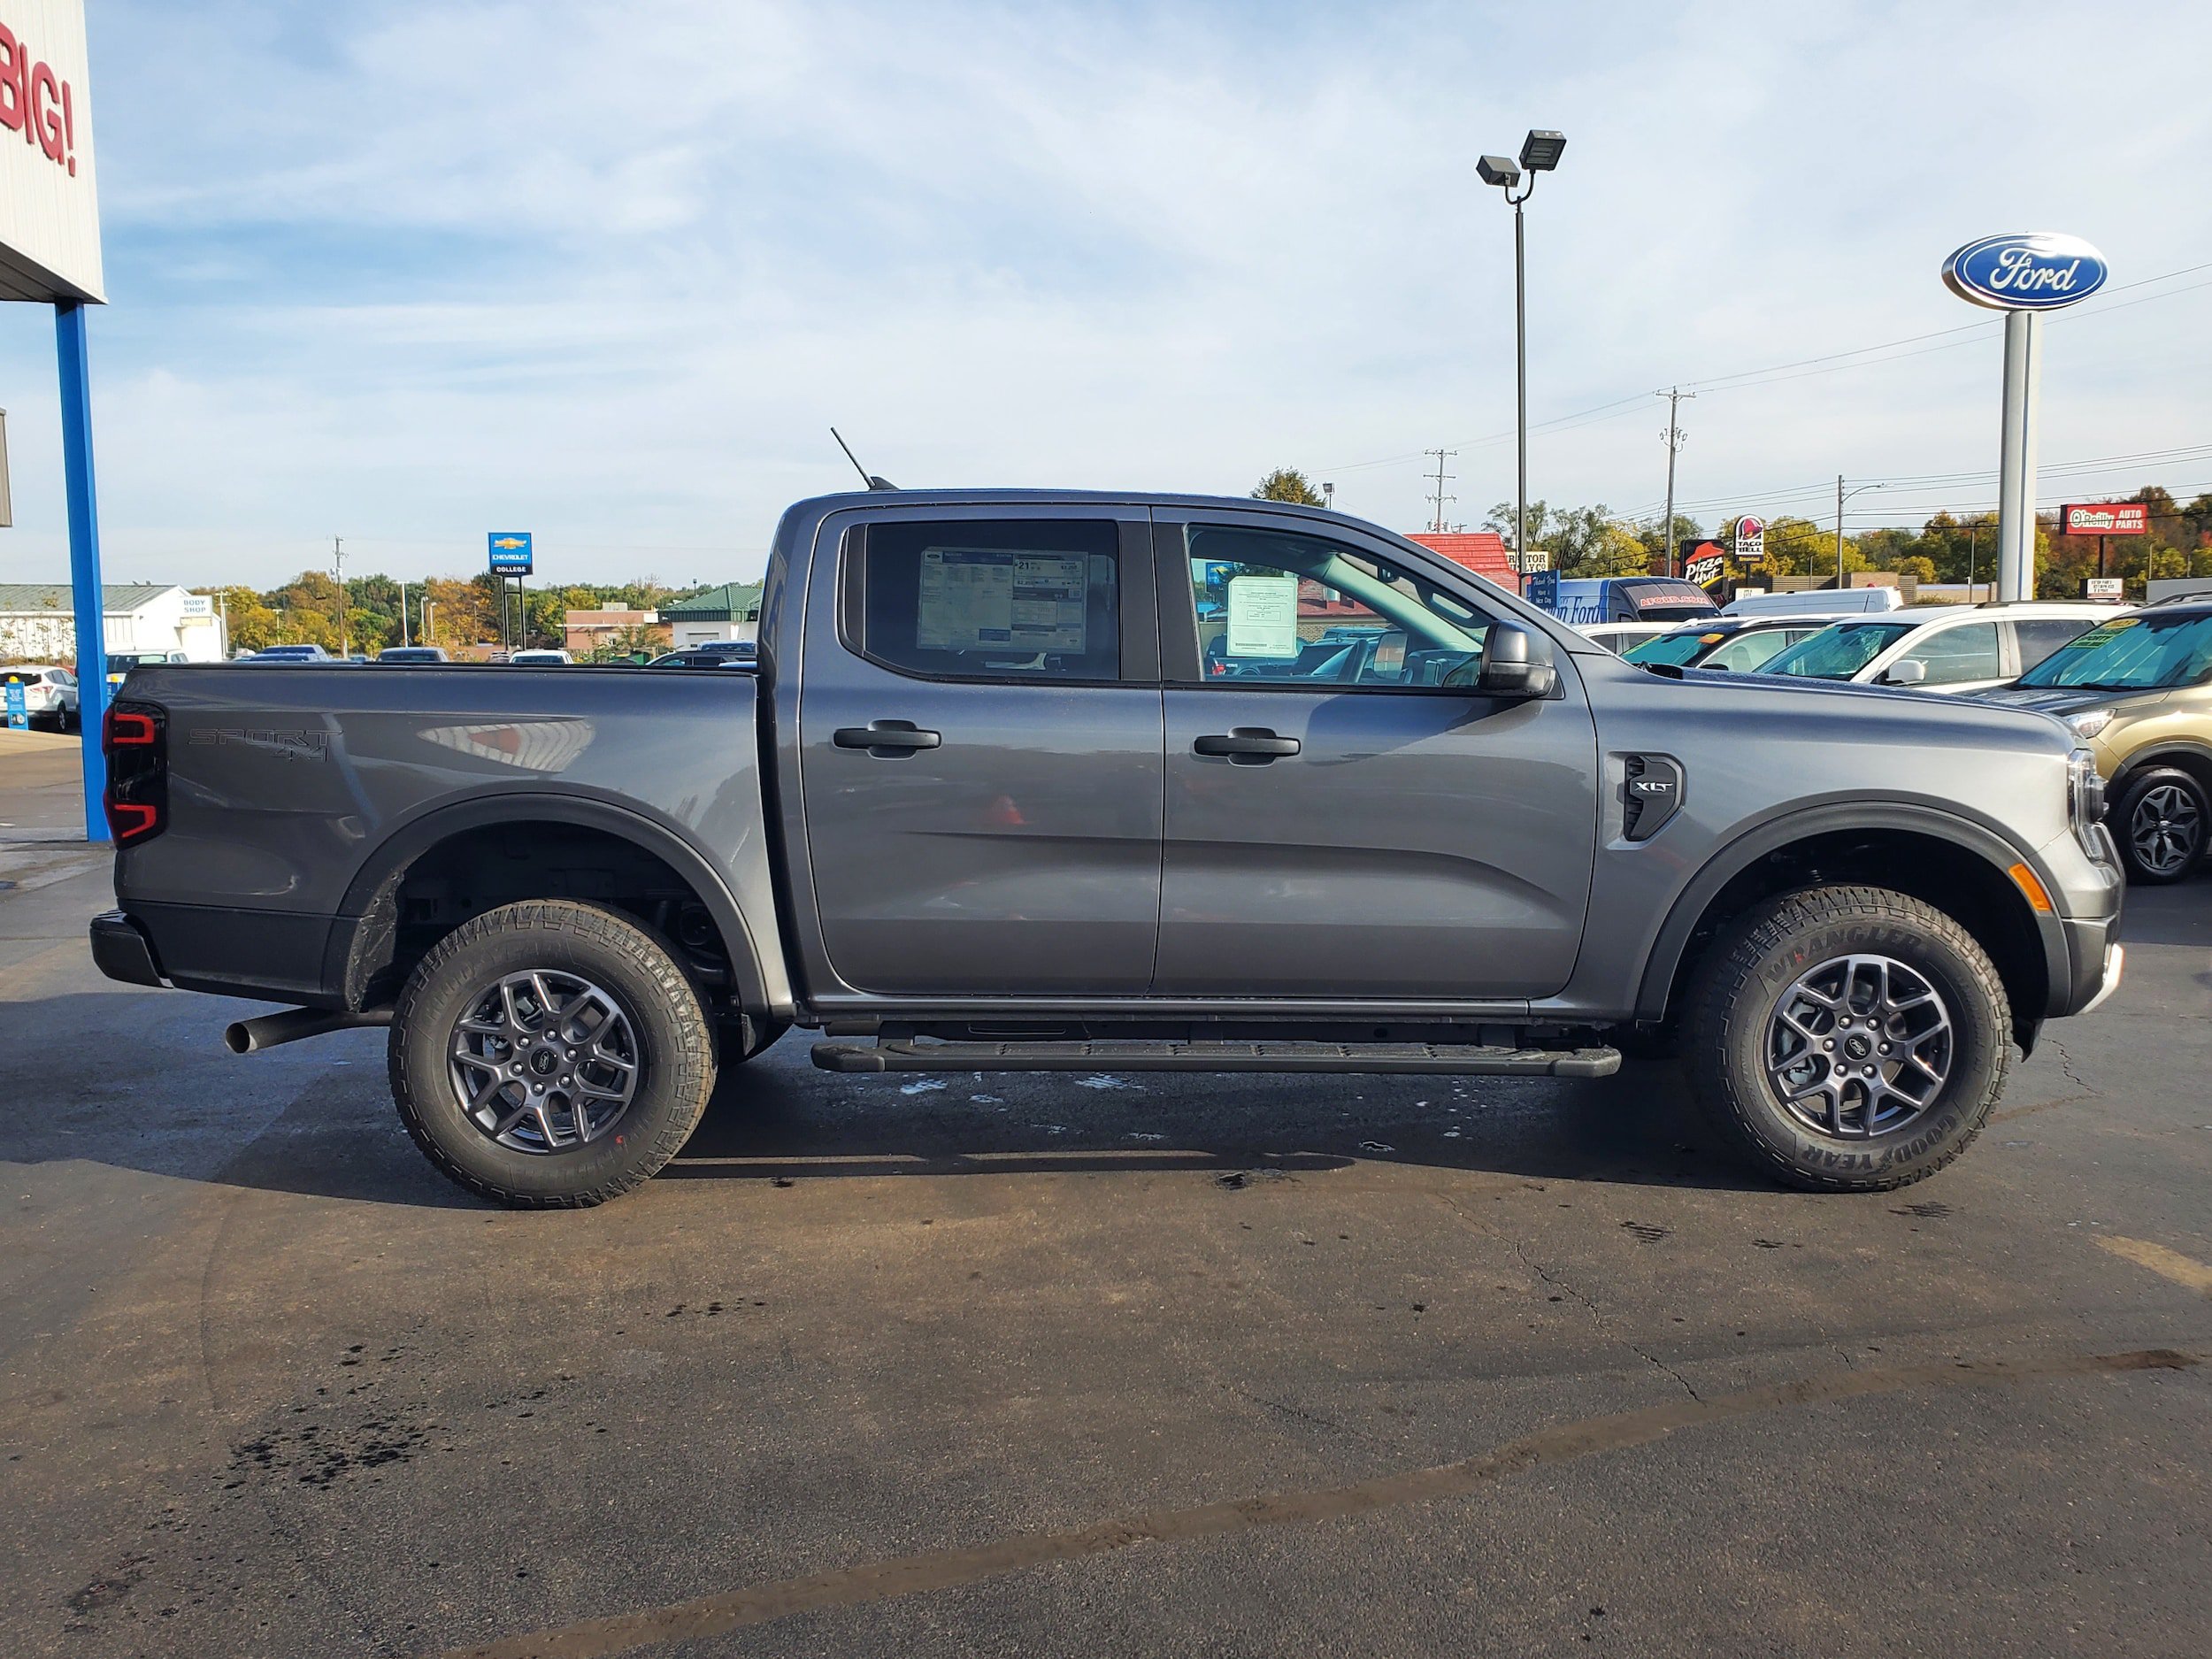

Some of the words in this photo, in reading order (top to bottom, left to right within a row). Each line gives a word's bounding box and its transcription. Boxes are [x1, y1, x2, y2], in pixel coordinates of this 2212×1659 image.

[0, 22, 76, 178] BIG!
[1989, 247, 2080, 291] Ford
[2070, 509, 2115, 529] O'Reilly
[2116, 519, 2143, 529] PARTS
[2119, 510, 2142, 518] AUTO
[1018, 561, 1029, 570] 21
[1685, 557, 1724, 580] Pizza
[1692, 568, 1721, 585] Hut
[1570, 595, 1603, 624] Ford
[188, 728, 344, 746] SPORT
[1635, 782, 1673, 792] XLT
[1763, 926, 1923, 985] WRANGLER
[1801, 1115, 1957, 1171] GOODYEAR
